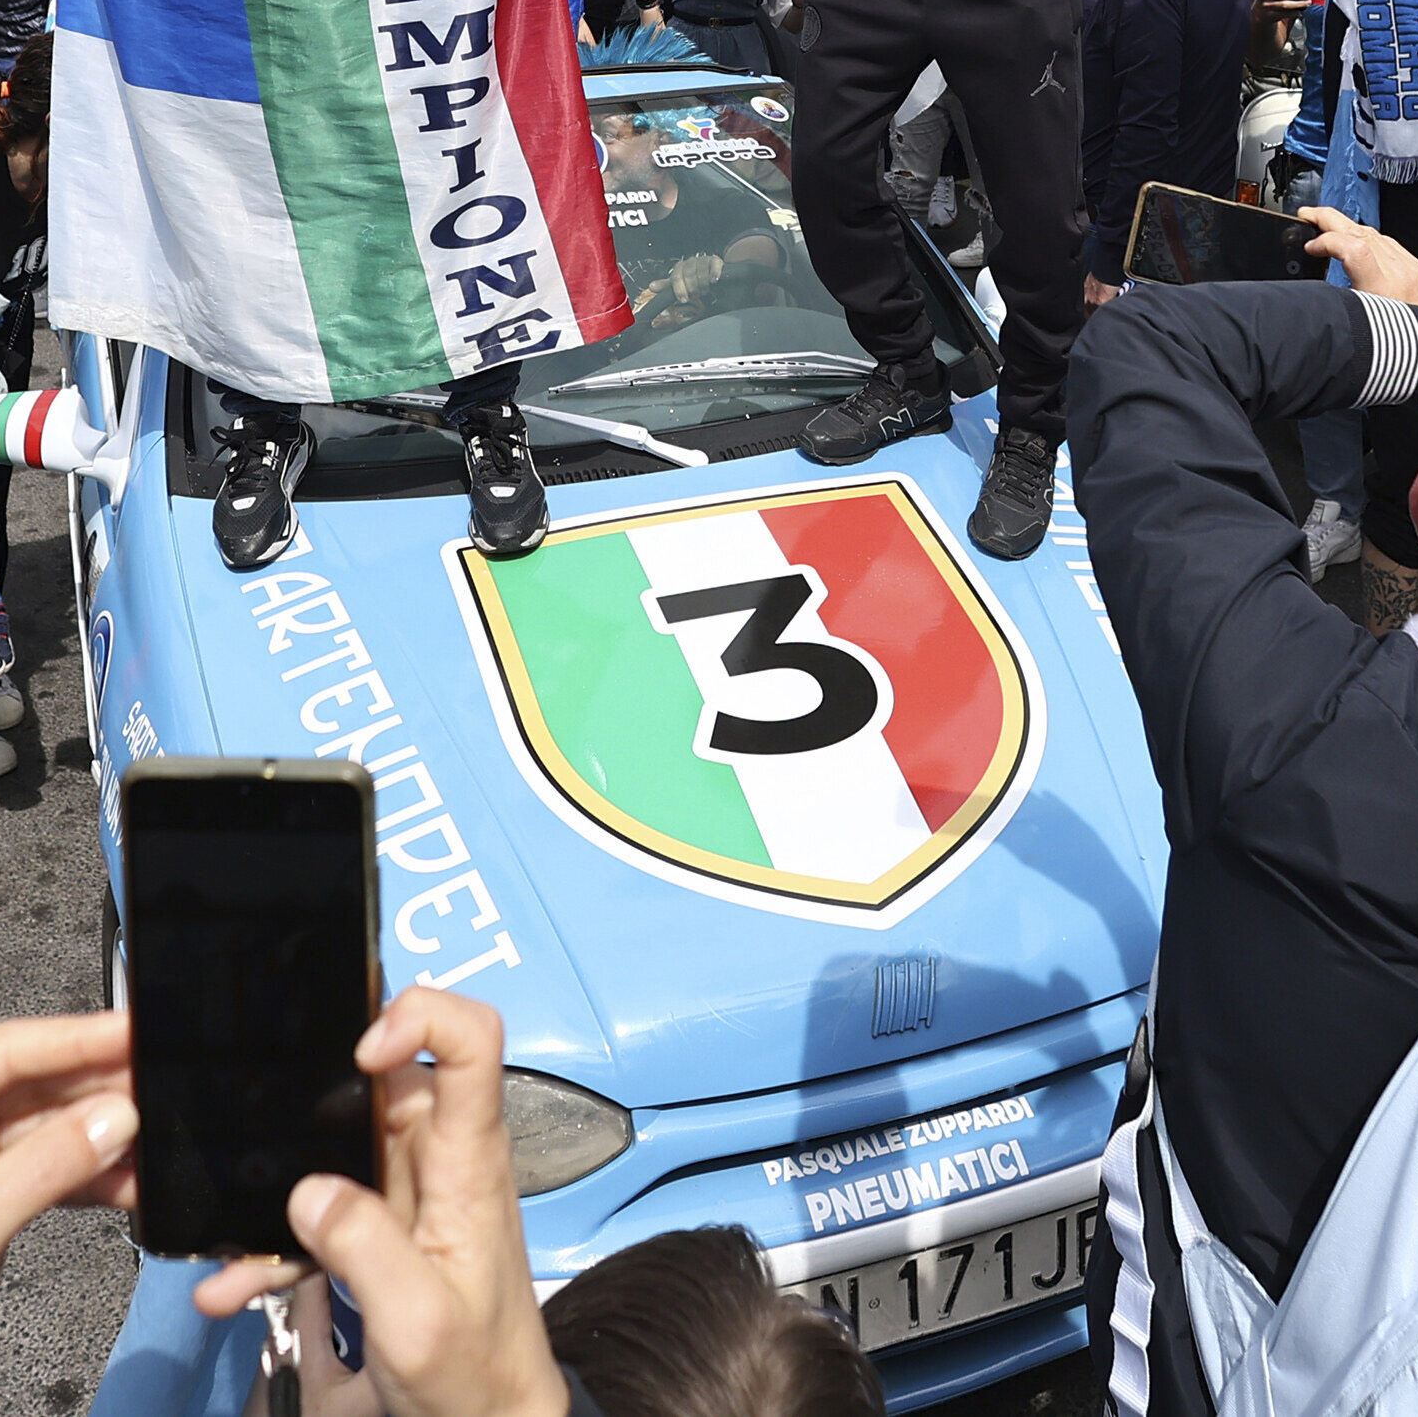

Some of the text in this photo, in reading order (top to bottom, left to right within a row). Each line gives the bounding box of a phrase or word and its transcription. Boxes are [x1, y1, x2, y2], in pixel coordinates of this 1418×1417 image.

[657, 573, 877, 756] 3
[762, 1096, 1035, 1186] PASQUALE ZUPPARDI
[805, 1139, 1030, 1232] PNEUMATICI
